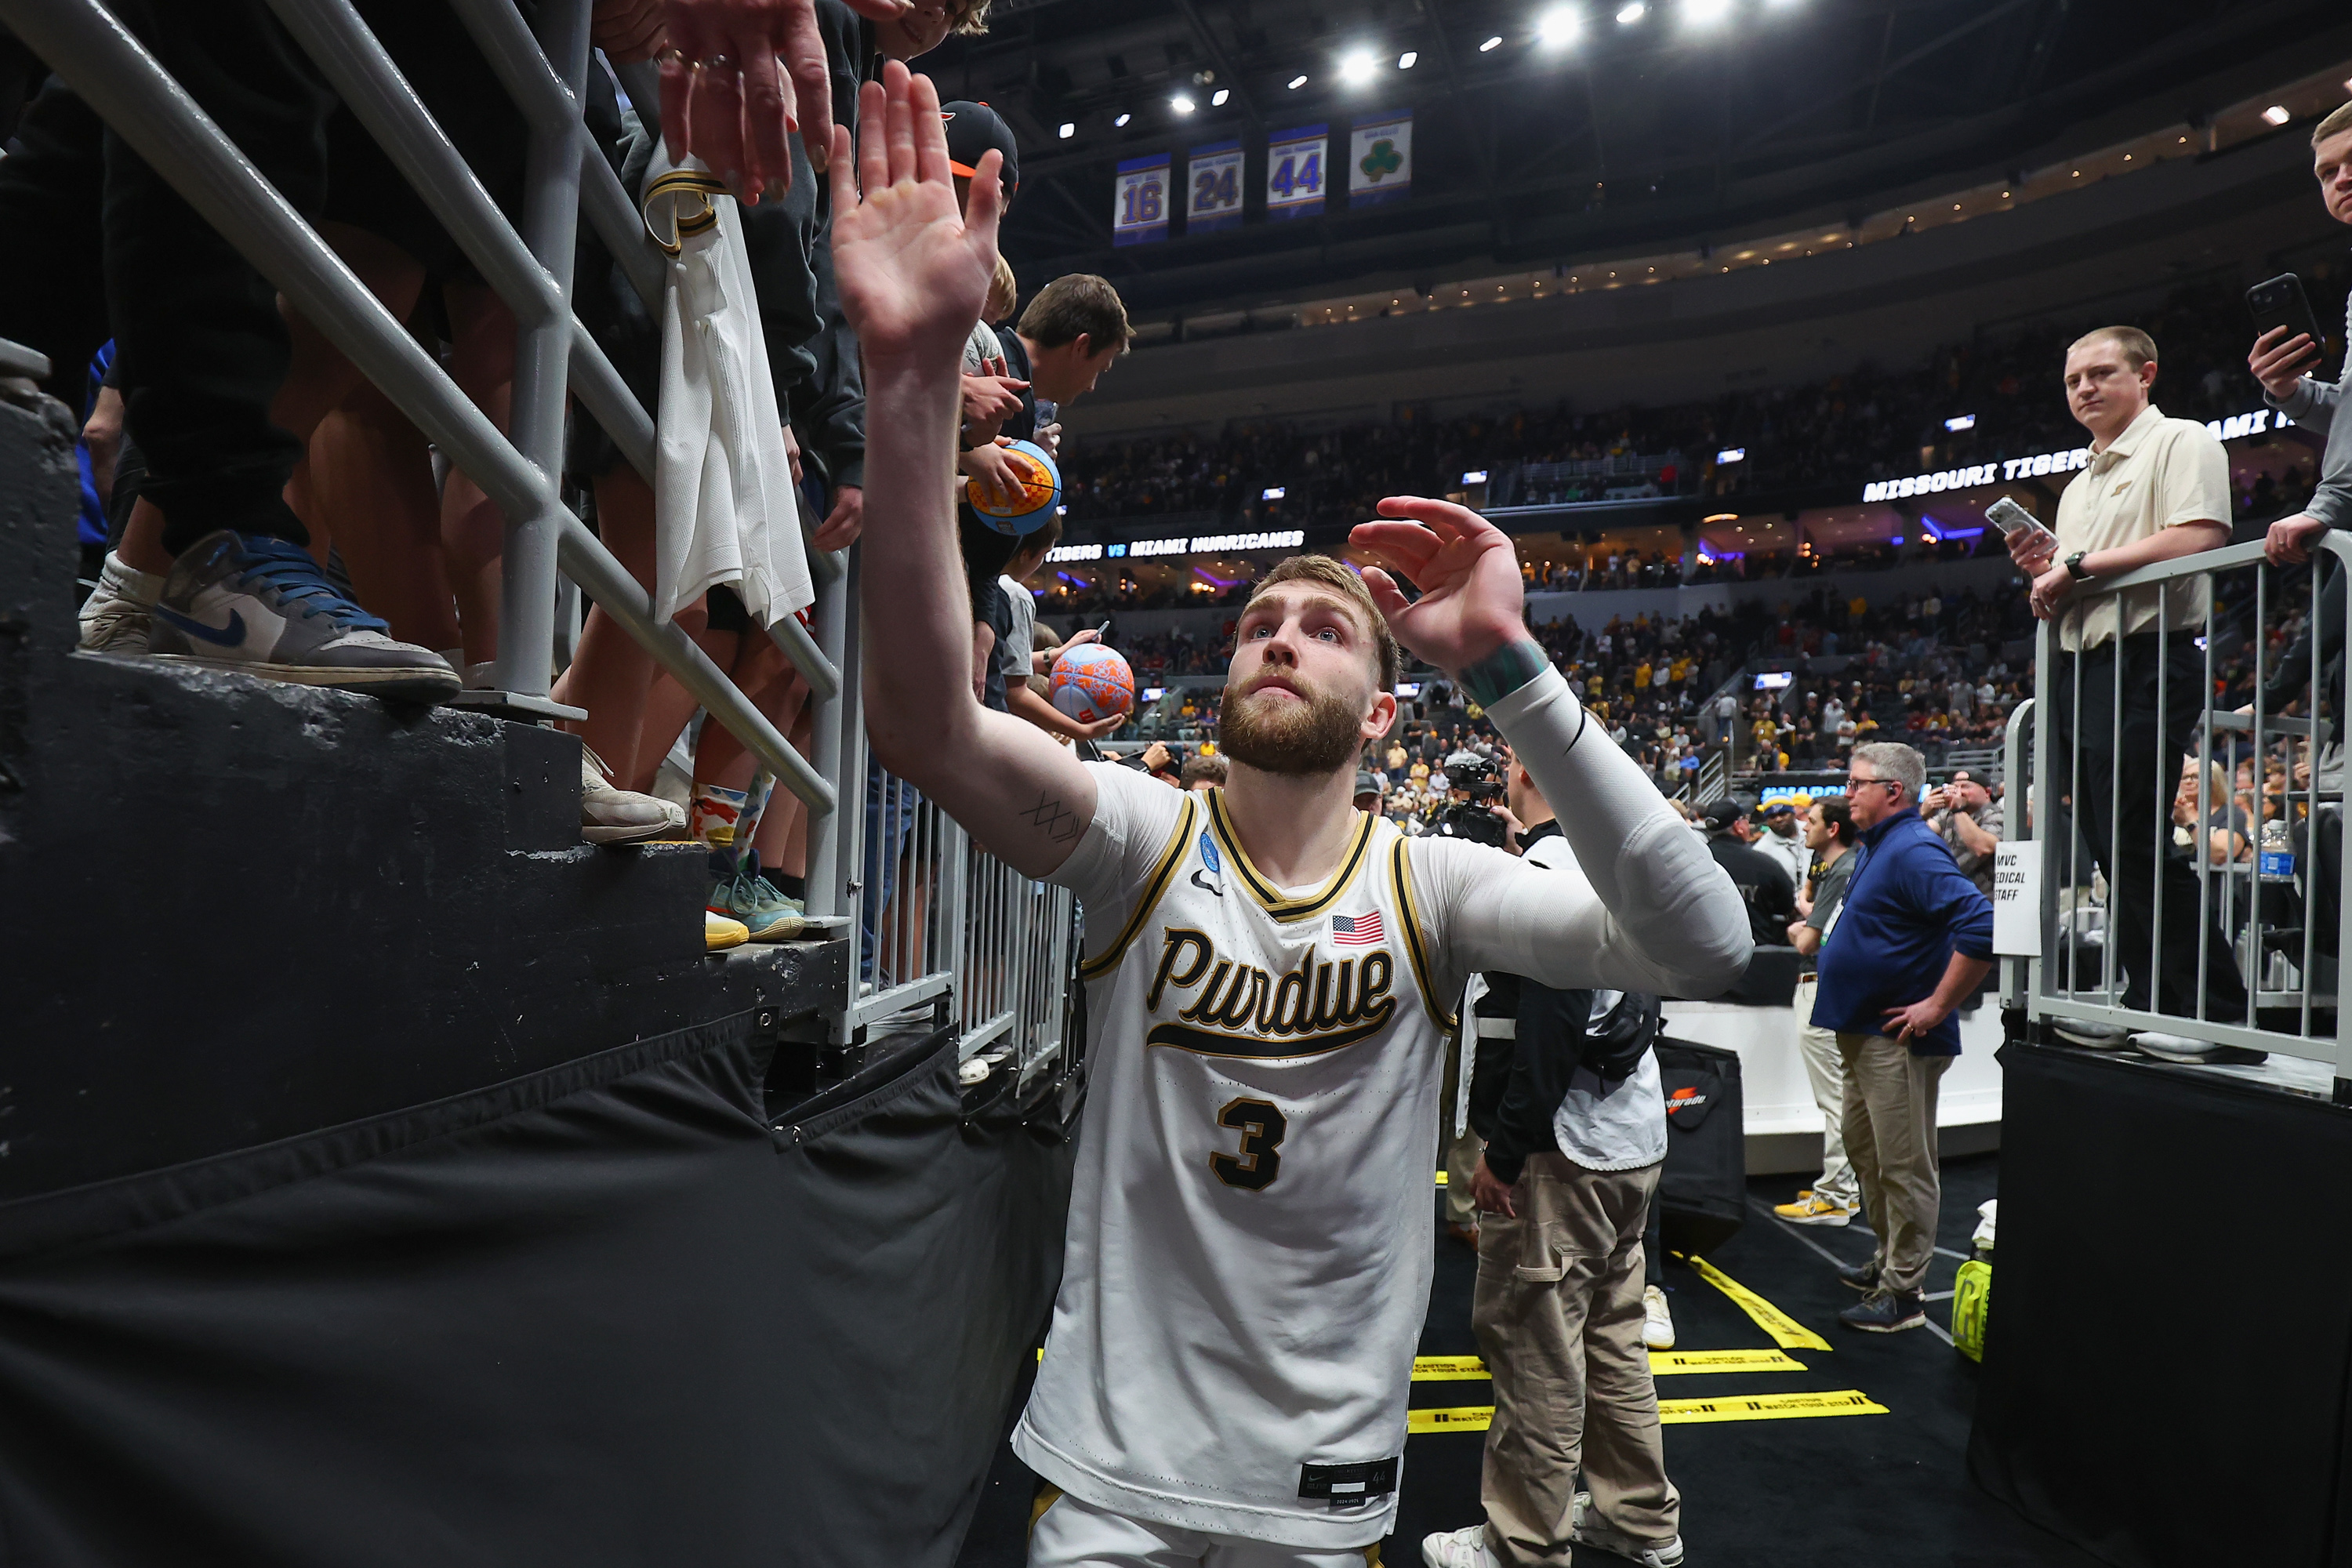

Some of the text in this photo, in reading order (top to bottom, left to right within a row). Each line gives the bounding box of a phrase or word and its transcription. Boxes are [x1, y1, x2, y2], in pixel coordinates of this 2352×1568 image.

[1193, 165, 1239, 211] 24
[1271, 153, 1323, 197] 44
[1122, 181, 1163, 225] 16
[1863, 463, 1998, 503] MISSOURI
[1107, 543, 1127, 557] VS
[1129, 538, 1189, 557] MIAMI
[1190, 530, 1305, 553] HURRICANES
[1994, 872, 2025, 884] EDICAL
[1997, 855, 2017, 866] MVC
[1994, 889, 2019, 901] STAFF
[1146, 926, 1398, 1039] Purdue
[1208, 1096, 1287, 1192] 3
